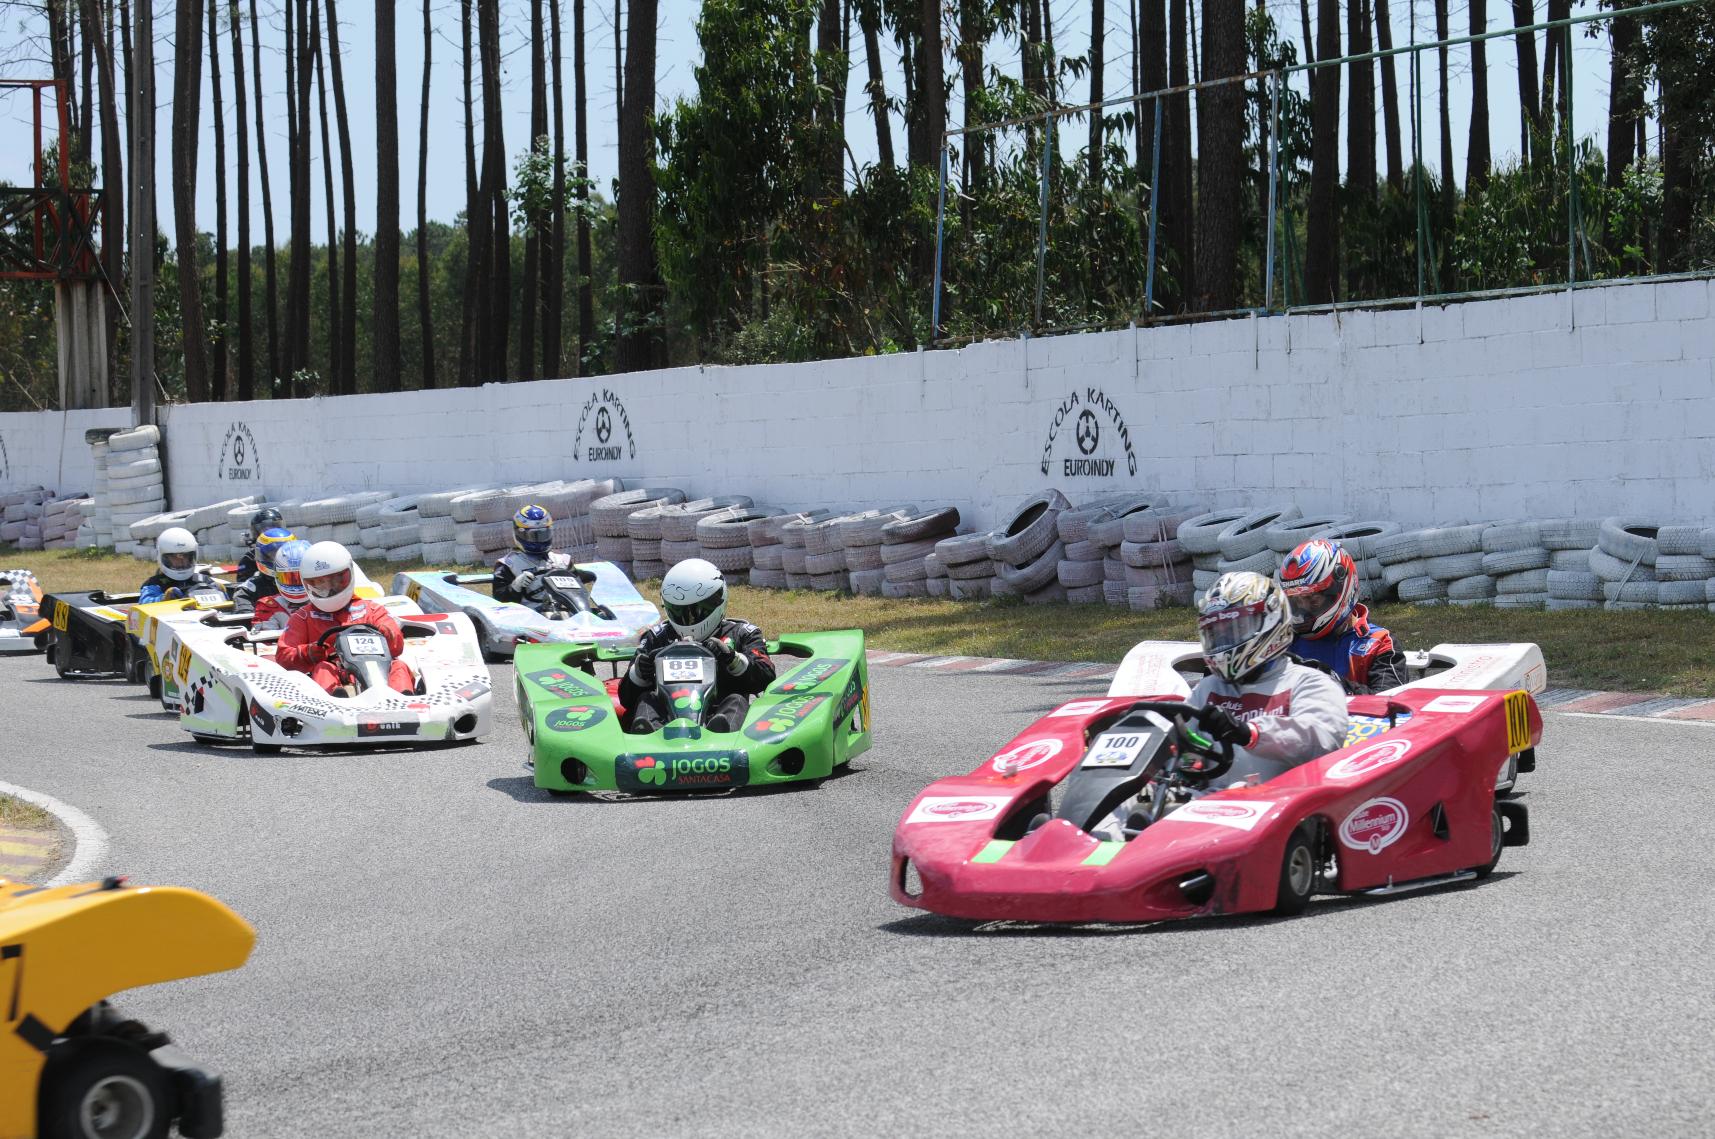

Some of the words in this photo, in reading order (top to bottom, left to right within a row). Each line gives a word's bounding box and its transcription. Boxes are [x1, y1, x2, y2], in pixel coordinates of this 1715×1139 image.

[573, 392, 598, 461] ESCOLA
[603, 389, 636, 459] KARTING
[1041, 391, 1079, 476] ESCOLA
[1087, 387, 1137, 477] KARTING
[589, 446, 622, 461] EUROINDY
[1063, 458, 1115, 477] EUROINDY
[1281, 578, 1306, 588] SHARK
[354, 637, 375, 645] 124
[668, 660, 699, 671] 89
[554, 720, 586, 728] JOGOS
[1507, 693, 1530, 749] 100
[1104, 736, 1140, 749] 100
[671, 758, 731, 780] JOGOS
[1349, 812, 1397, 834] Millennium
